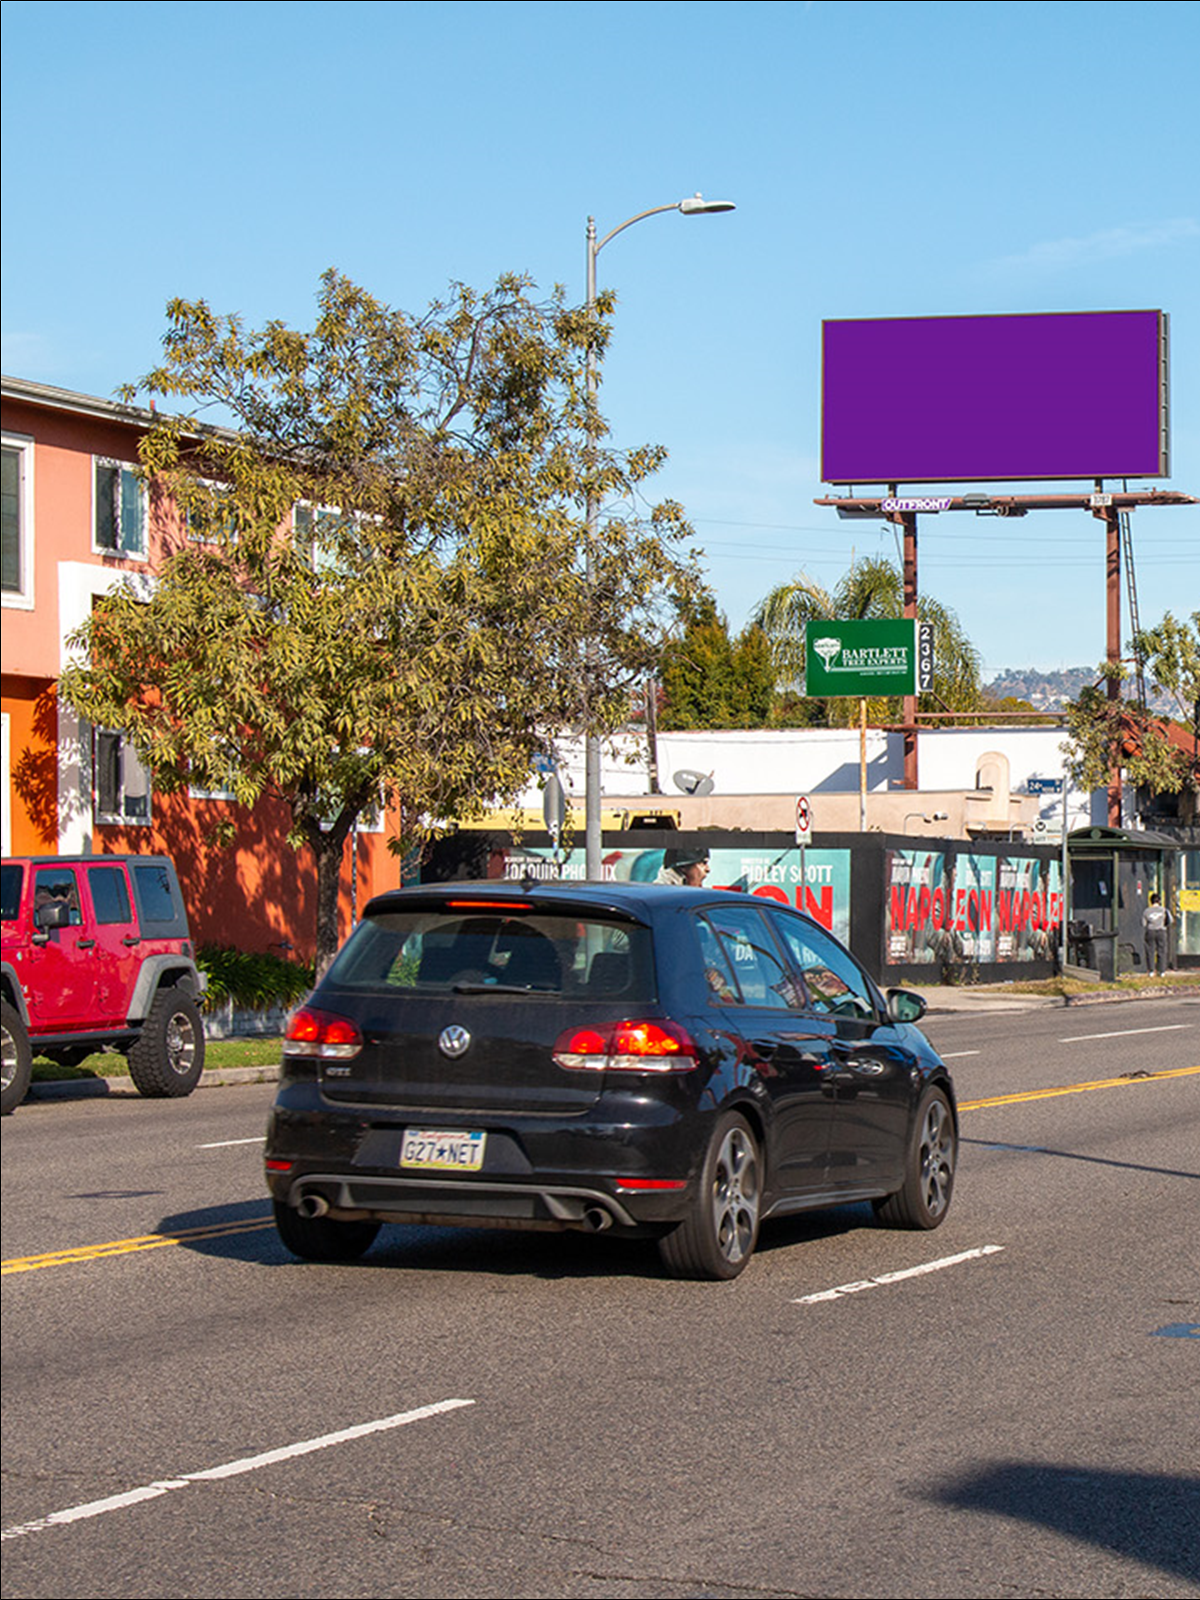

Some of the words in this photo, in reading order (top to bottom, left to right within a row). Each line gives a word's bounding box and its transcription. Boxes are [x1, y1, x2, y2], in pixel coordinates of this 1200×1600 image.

[885, 499, 949, 510] OUTFRONT
[842, 647, 908, 659] BARTLETT
[920, 627, 931, 688] 2367
[842, 659, 865, 667] TREE
[868, 658, 908, 666] EXPERTS
[741, 865, 787, 883] RIDLEY
[890, 886, 992, 932] NAPOLEON
[1000, 890, 1064, 932] NAPOLE
